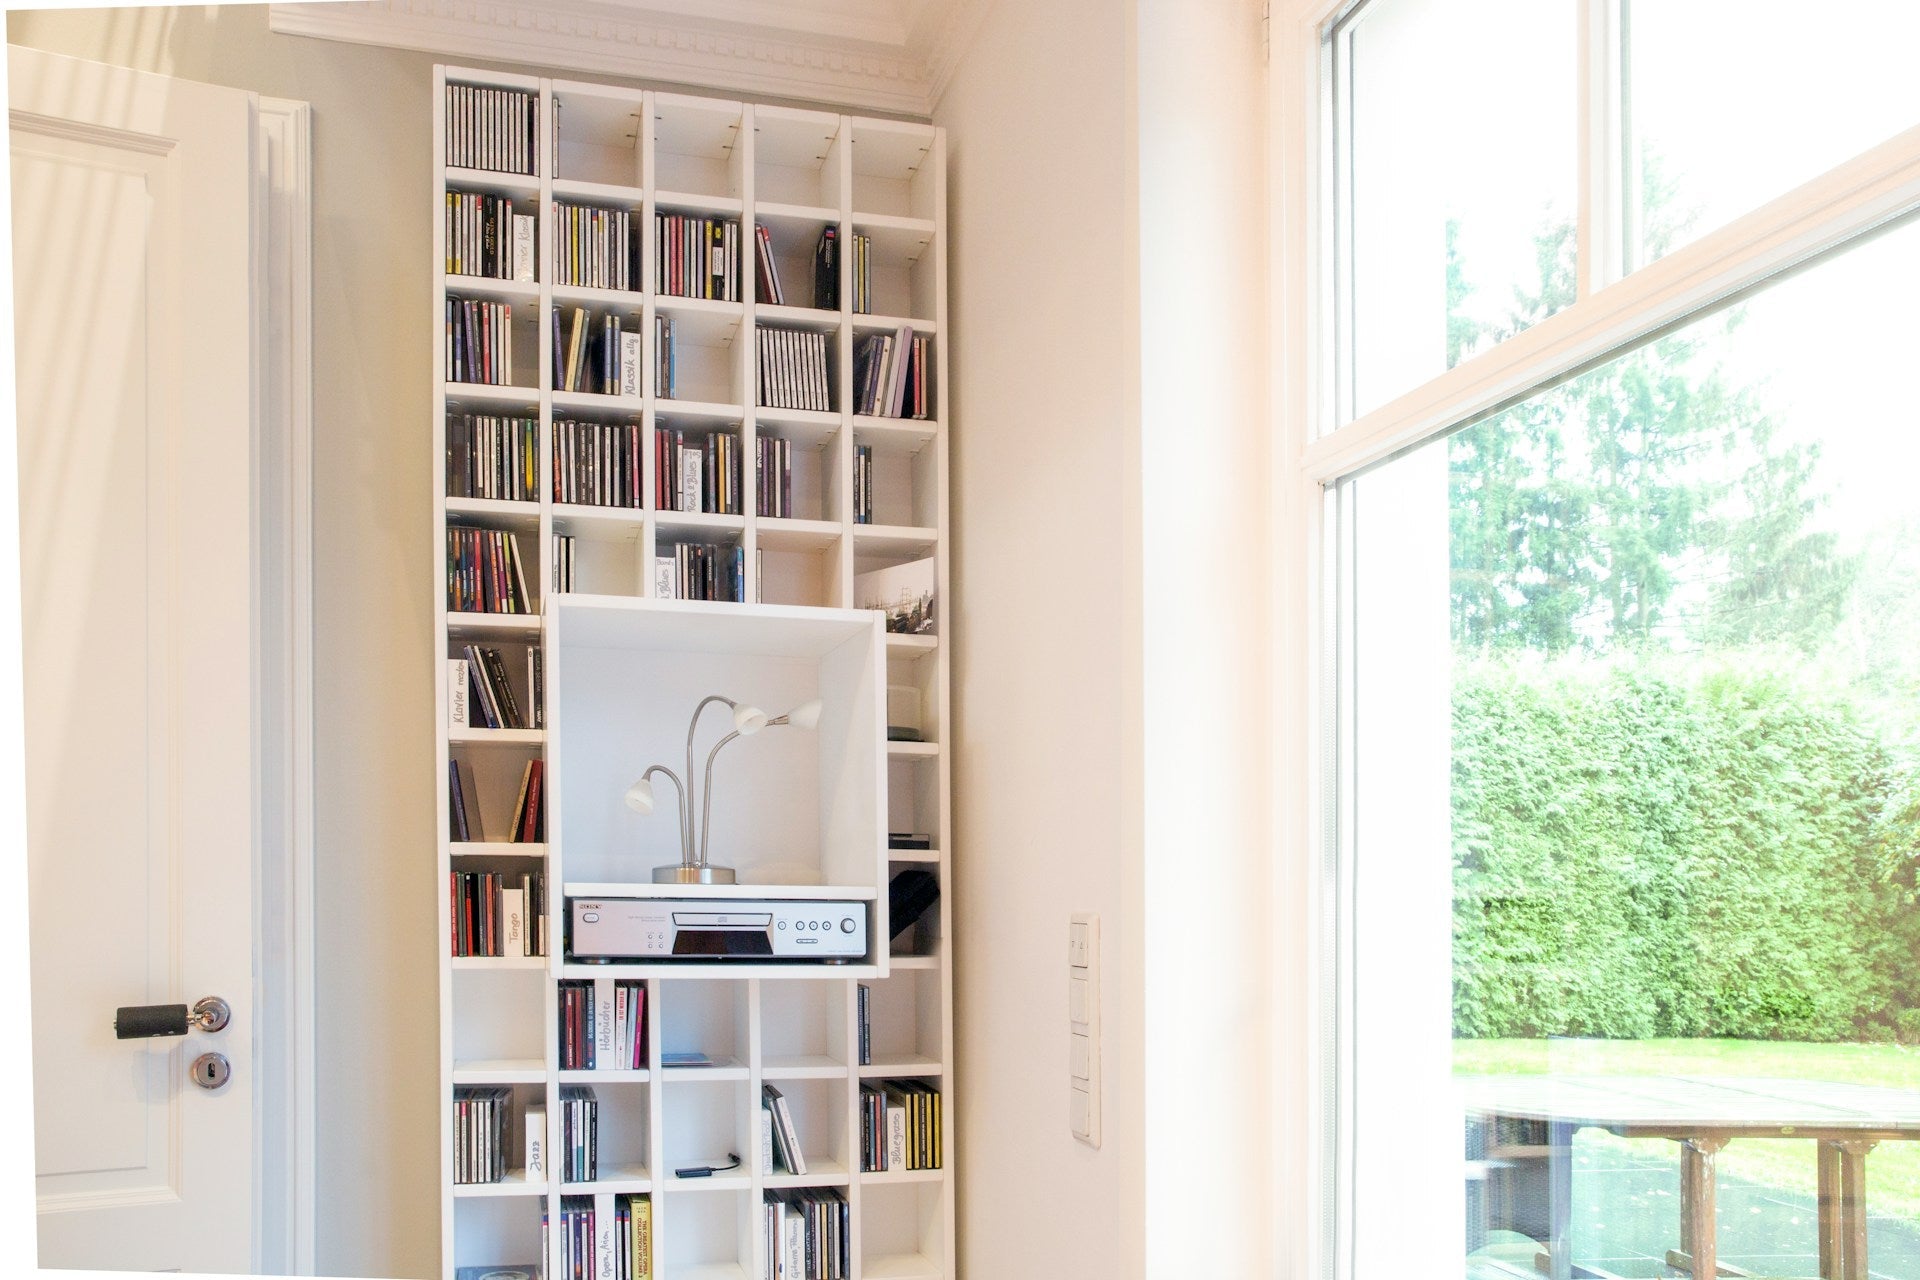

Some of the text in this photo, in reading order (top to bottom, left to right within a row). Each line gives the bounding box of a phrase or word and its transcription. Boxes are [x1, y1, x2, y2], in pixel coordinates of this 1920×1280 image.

[624, 335, 639, 396] Klassik allg.
[686, 461, 698, 485] Blues
[453, 690, 464, 723] Klavier
[509, 912, 520, 944] Tango
[598, 1000, 611, 1051] Hörbücher
[891, 1113, 904, 1165] Bluegrass
[529, 1140, 541, 1172] Jazz
